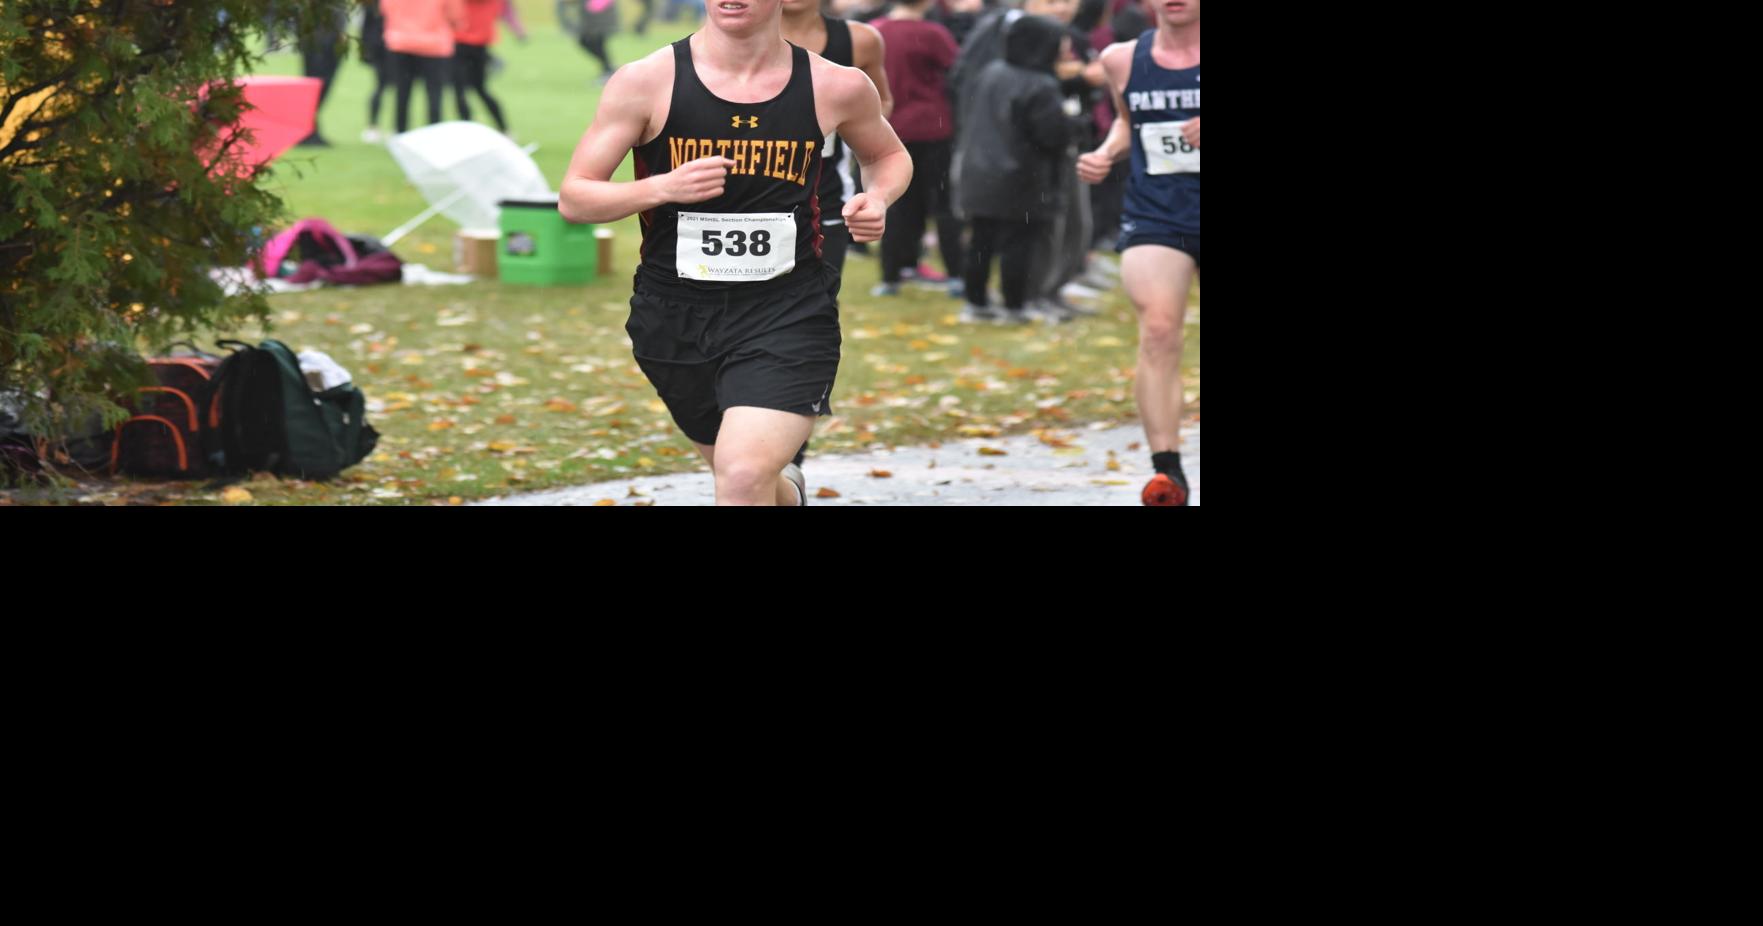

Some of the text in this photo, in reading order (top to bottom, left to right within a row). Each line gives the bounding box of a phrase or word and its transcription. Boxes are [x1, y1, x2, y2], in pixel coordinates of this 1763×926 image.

[701, 229, 771, 256] 538
[707, 266, 777, 274] WAYZATA RESULTS
